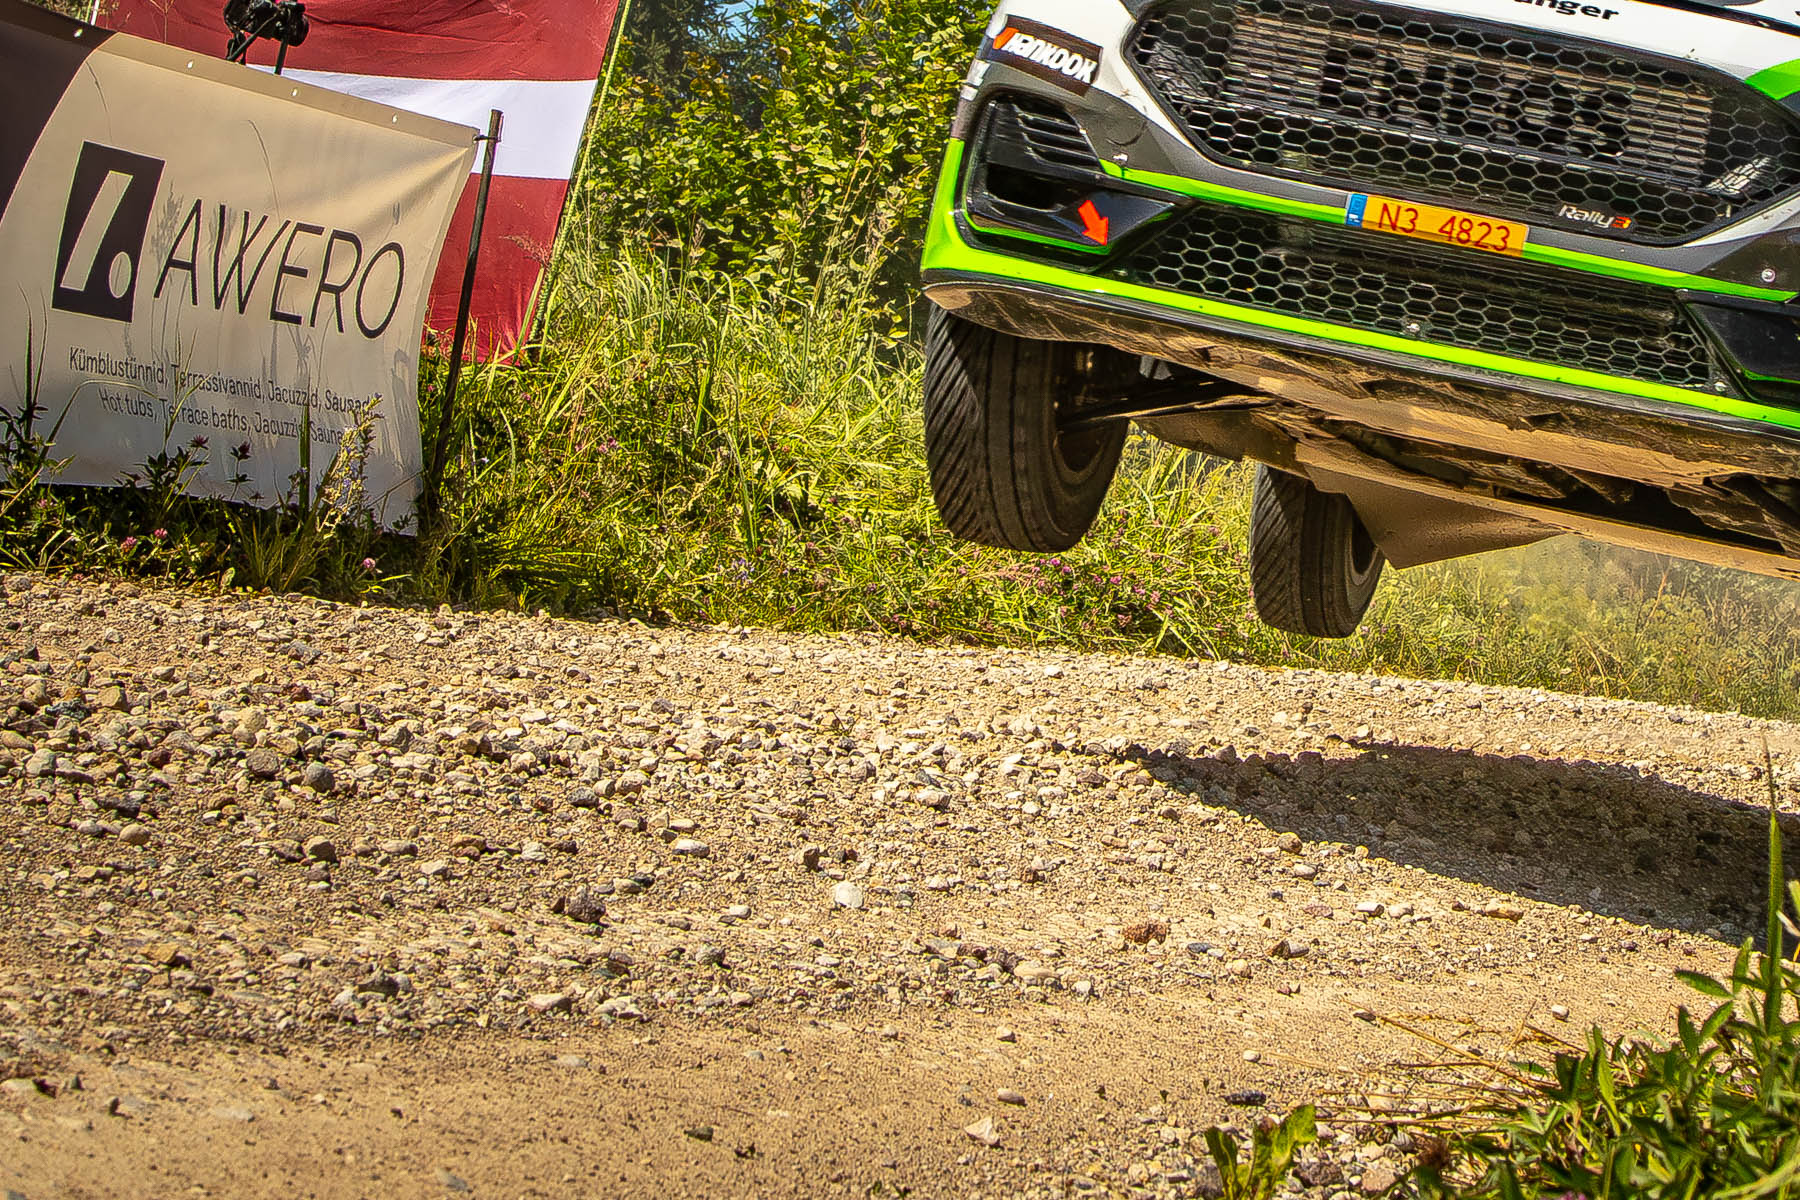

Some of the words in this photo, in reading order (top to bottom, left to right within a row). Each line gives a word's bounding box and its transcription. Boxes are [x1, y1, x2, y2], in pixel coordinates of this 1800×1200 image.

[1377, 202, 1420, 234] N3
[1438, 215, 1512, 252] 4823
[1558, 204, 1633, 230] Rally3
[154, 198, 405, 339] AWERO
[69, 346, 168, 386] Kümblustünnid,
[99, 388, 124, 413] Hot
[125, 394, 159, 424] tubs,
[211, 405, 251, 436] baths,
